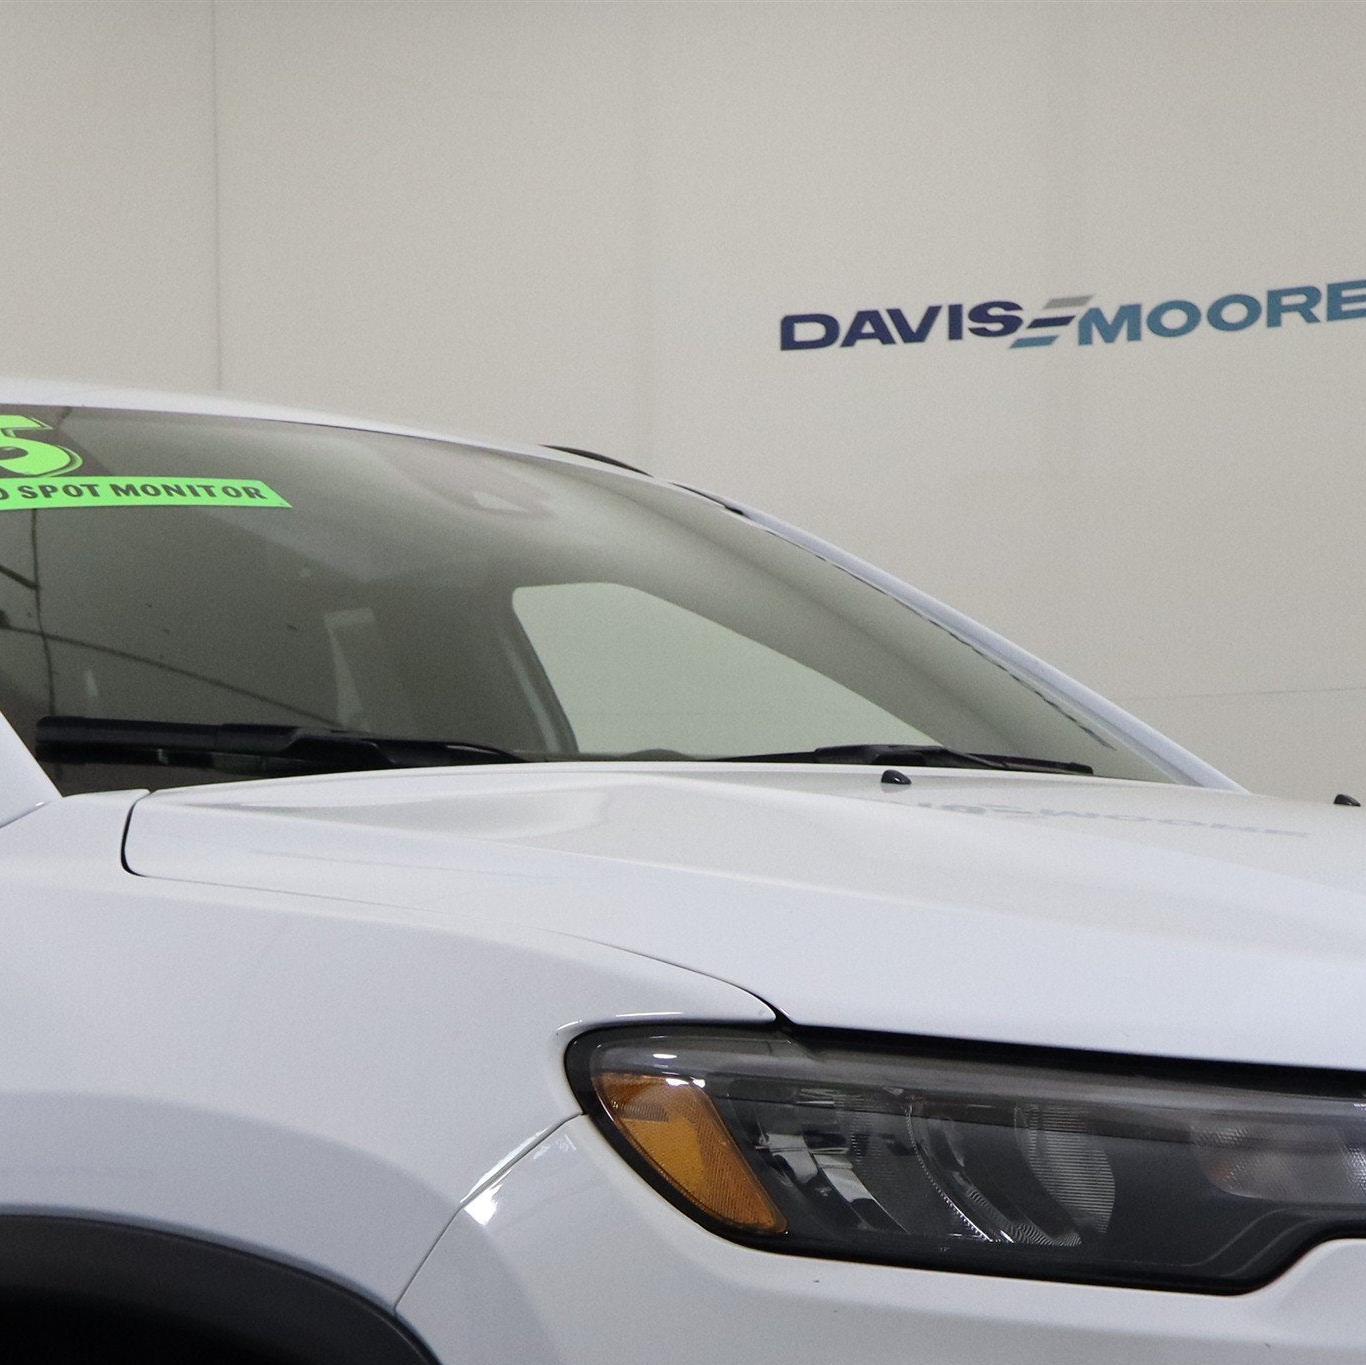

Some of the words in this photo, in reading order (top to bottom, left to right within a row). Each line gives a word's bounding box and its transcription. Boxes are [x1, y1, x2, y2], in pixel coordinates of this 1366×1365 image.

[779, 301, 1025, 351] DAVIS
[17, 483, 101, 500] SPOT
[109, 483, 268, 500] MONITOR
